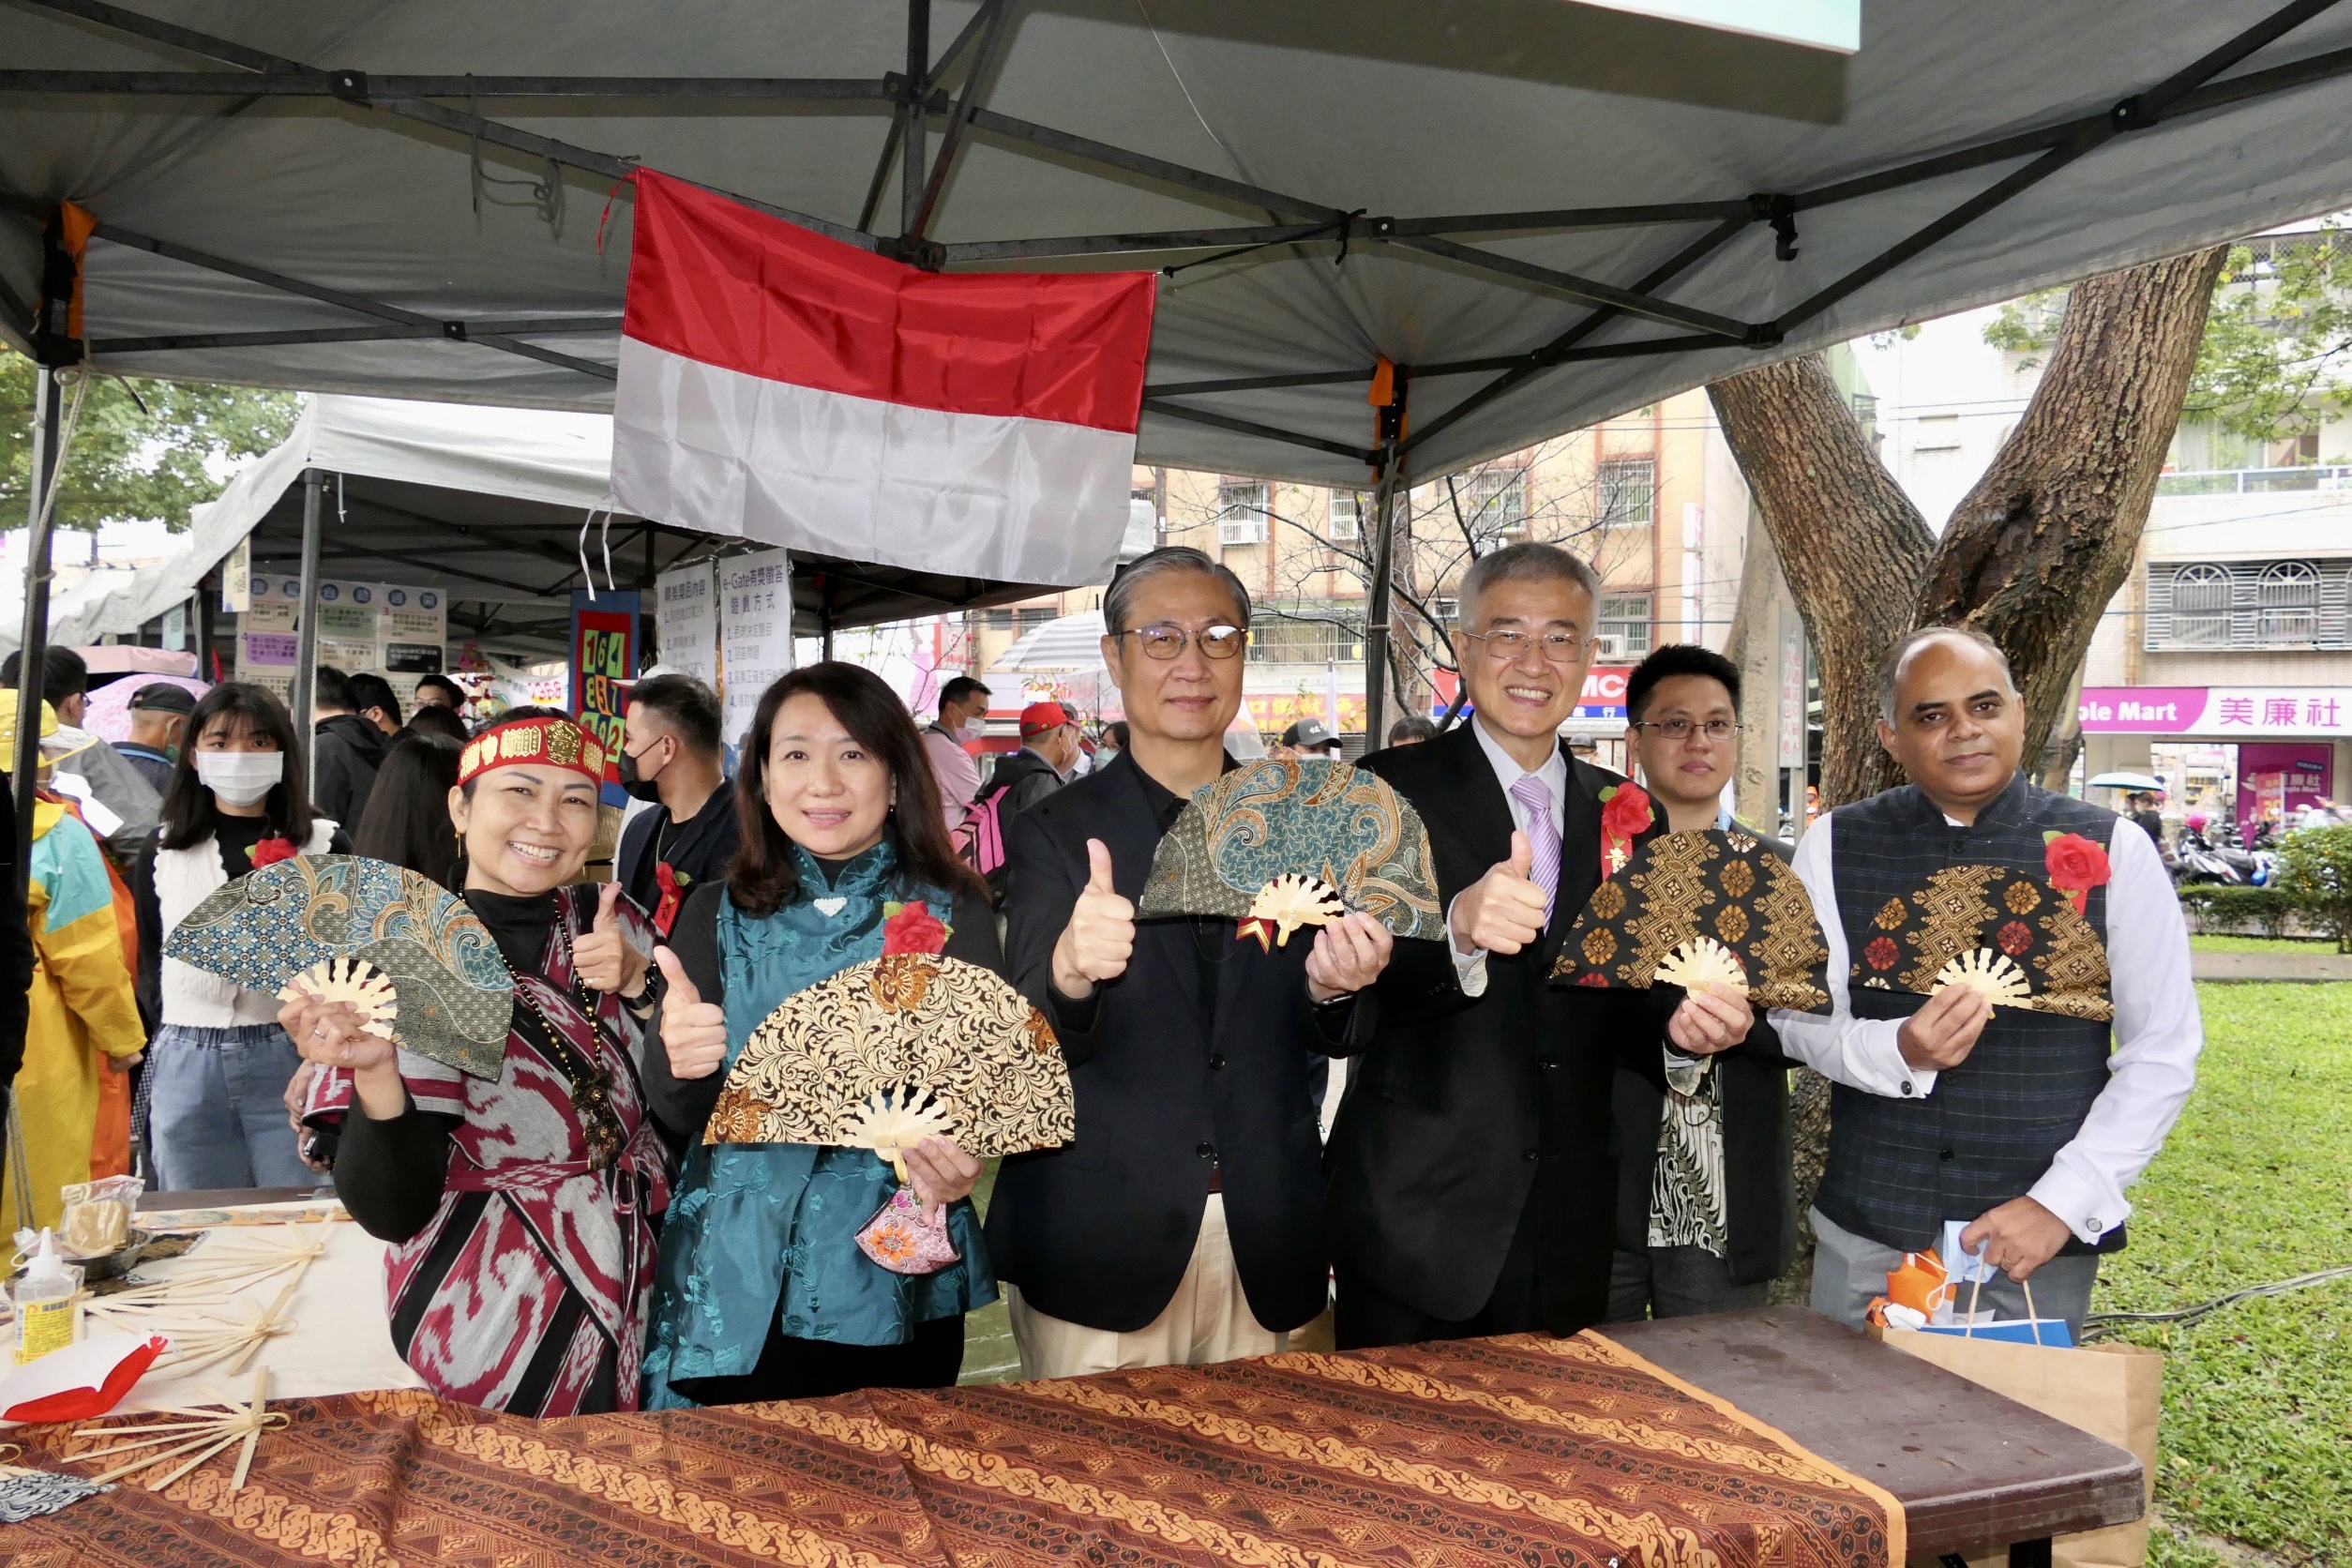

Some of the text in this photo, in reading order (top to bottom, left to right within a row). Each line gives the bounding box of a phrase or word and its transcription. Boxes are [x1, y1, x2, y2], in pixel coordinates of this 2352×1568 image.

[586, 635, 596, 666] 1
[598, 638, 607, 668] 6
[586, 677, 596, 709] 8
[1579, 674, 1627, 699] MC
[2118, 701, 2178, 721] Mart
[2219, 697, 2341, 727] 美廉社
[607, 725, 620, 756] 2
